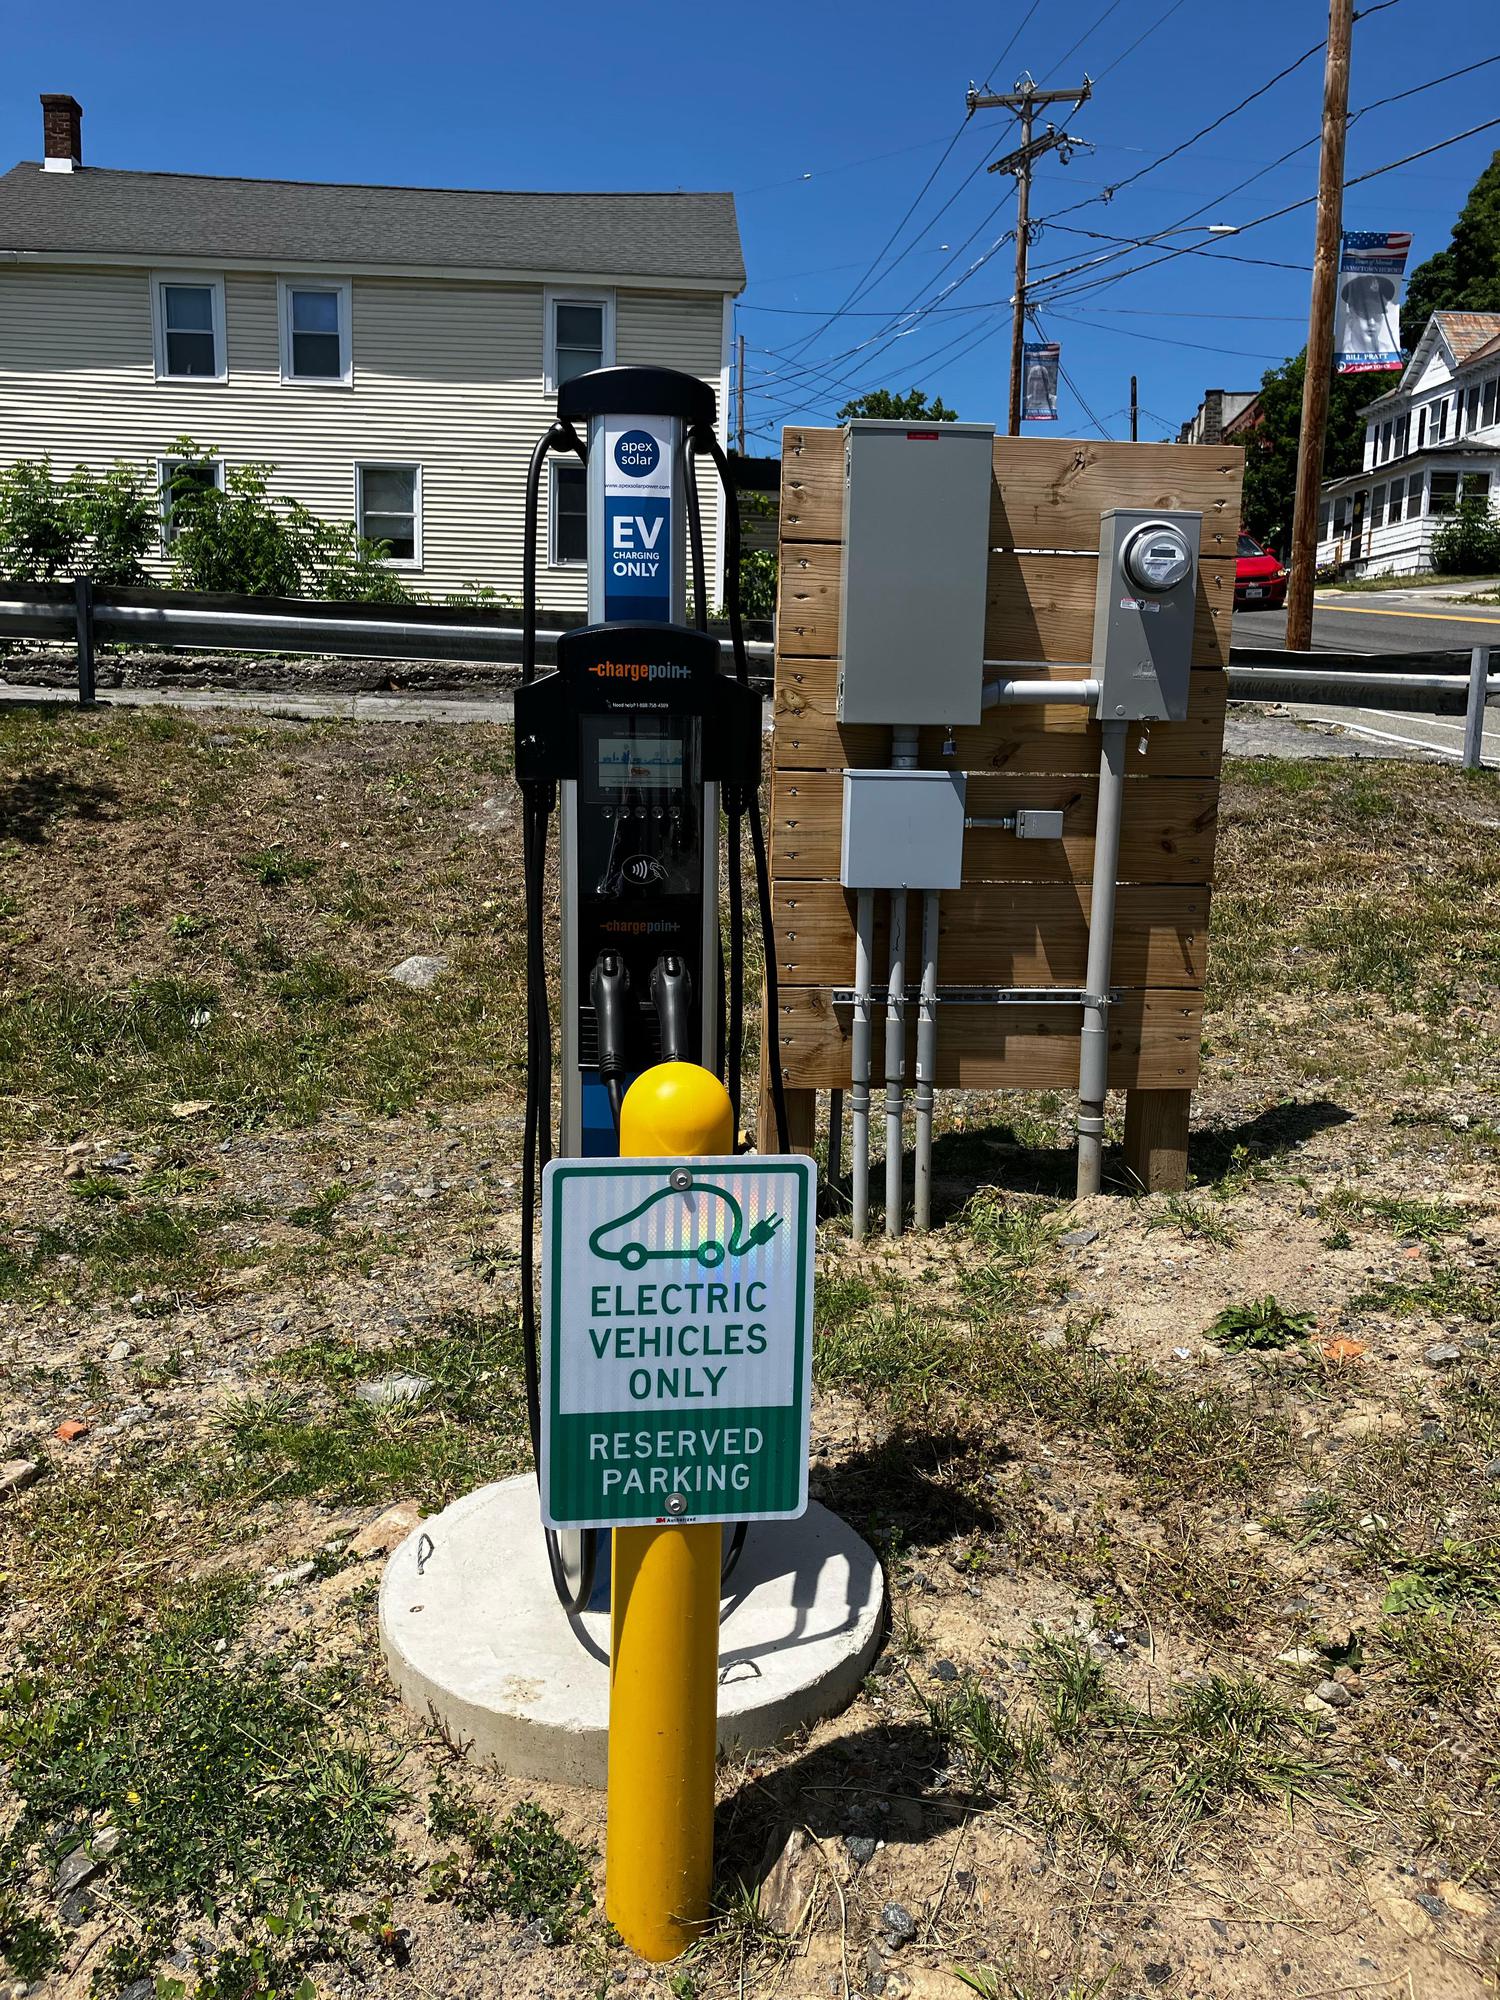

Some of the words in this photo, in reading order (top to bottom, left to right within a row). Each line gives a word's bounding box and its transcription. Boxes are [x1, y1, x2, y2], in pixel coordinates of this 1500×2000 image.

[621, 442, 653, 454] apex
[621, 453, 653, 465] solar
[613, 515, 664, 549] EV
[613, 551, 660, 560] CHARGING
[613, 562, 659, 577] ONLY
[592, 1281, 768, 1317] ELECTRIC
[588, 1323, 768, 1359] VEHICLES
[629, 1366, 728, 1399] ONLY
[589, 1427, 764, 1461] RESERVED
[602, 1463, 750, 1496] PARKING
